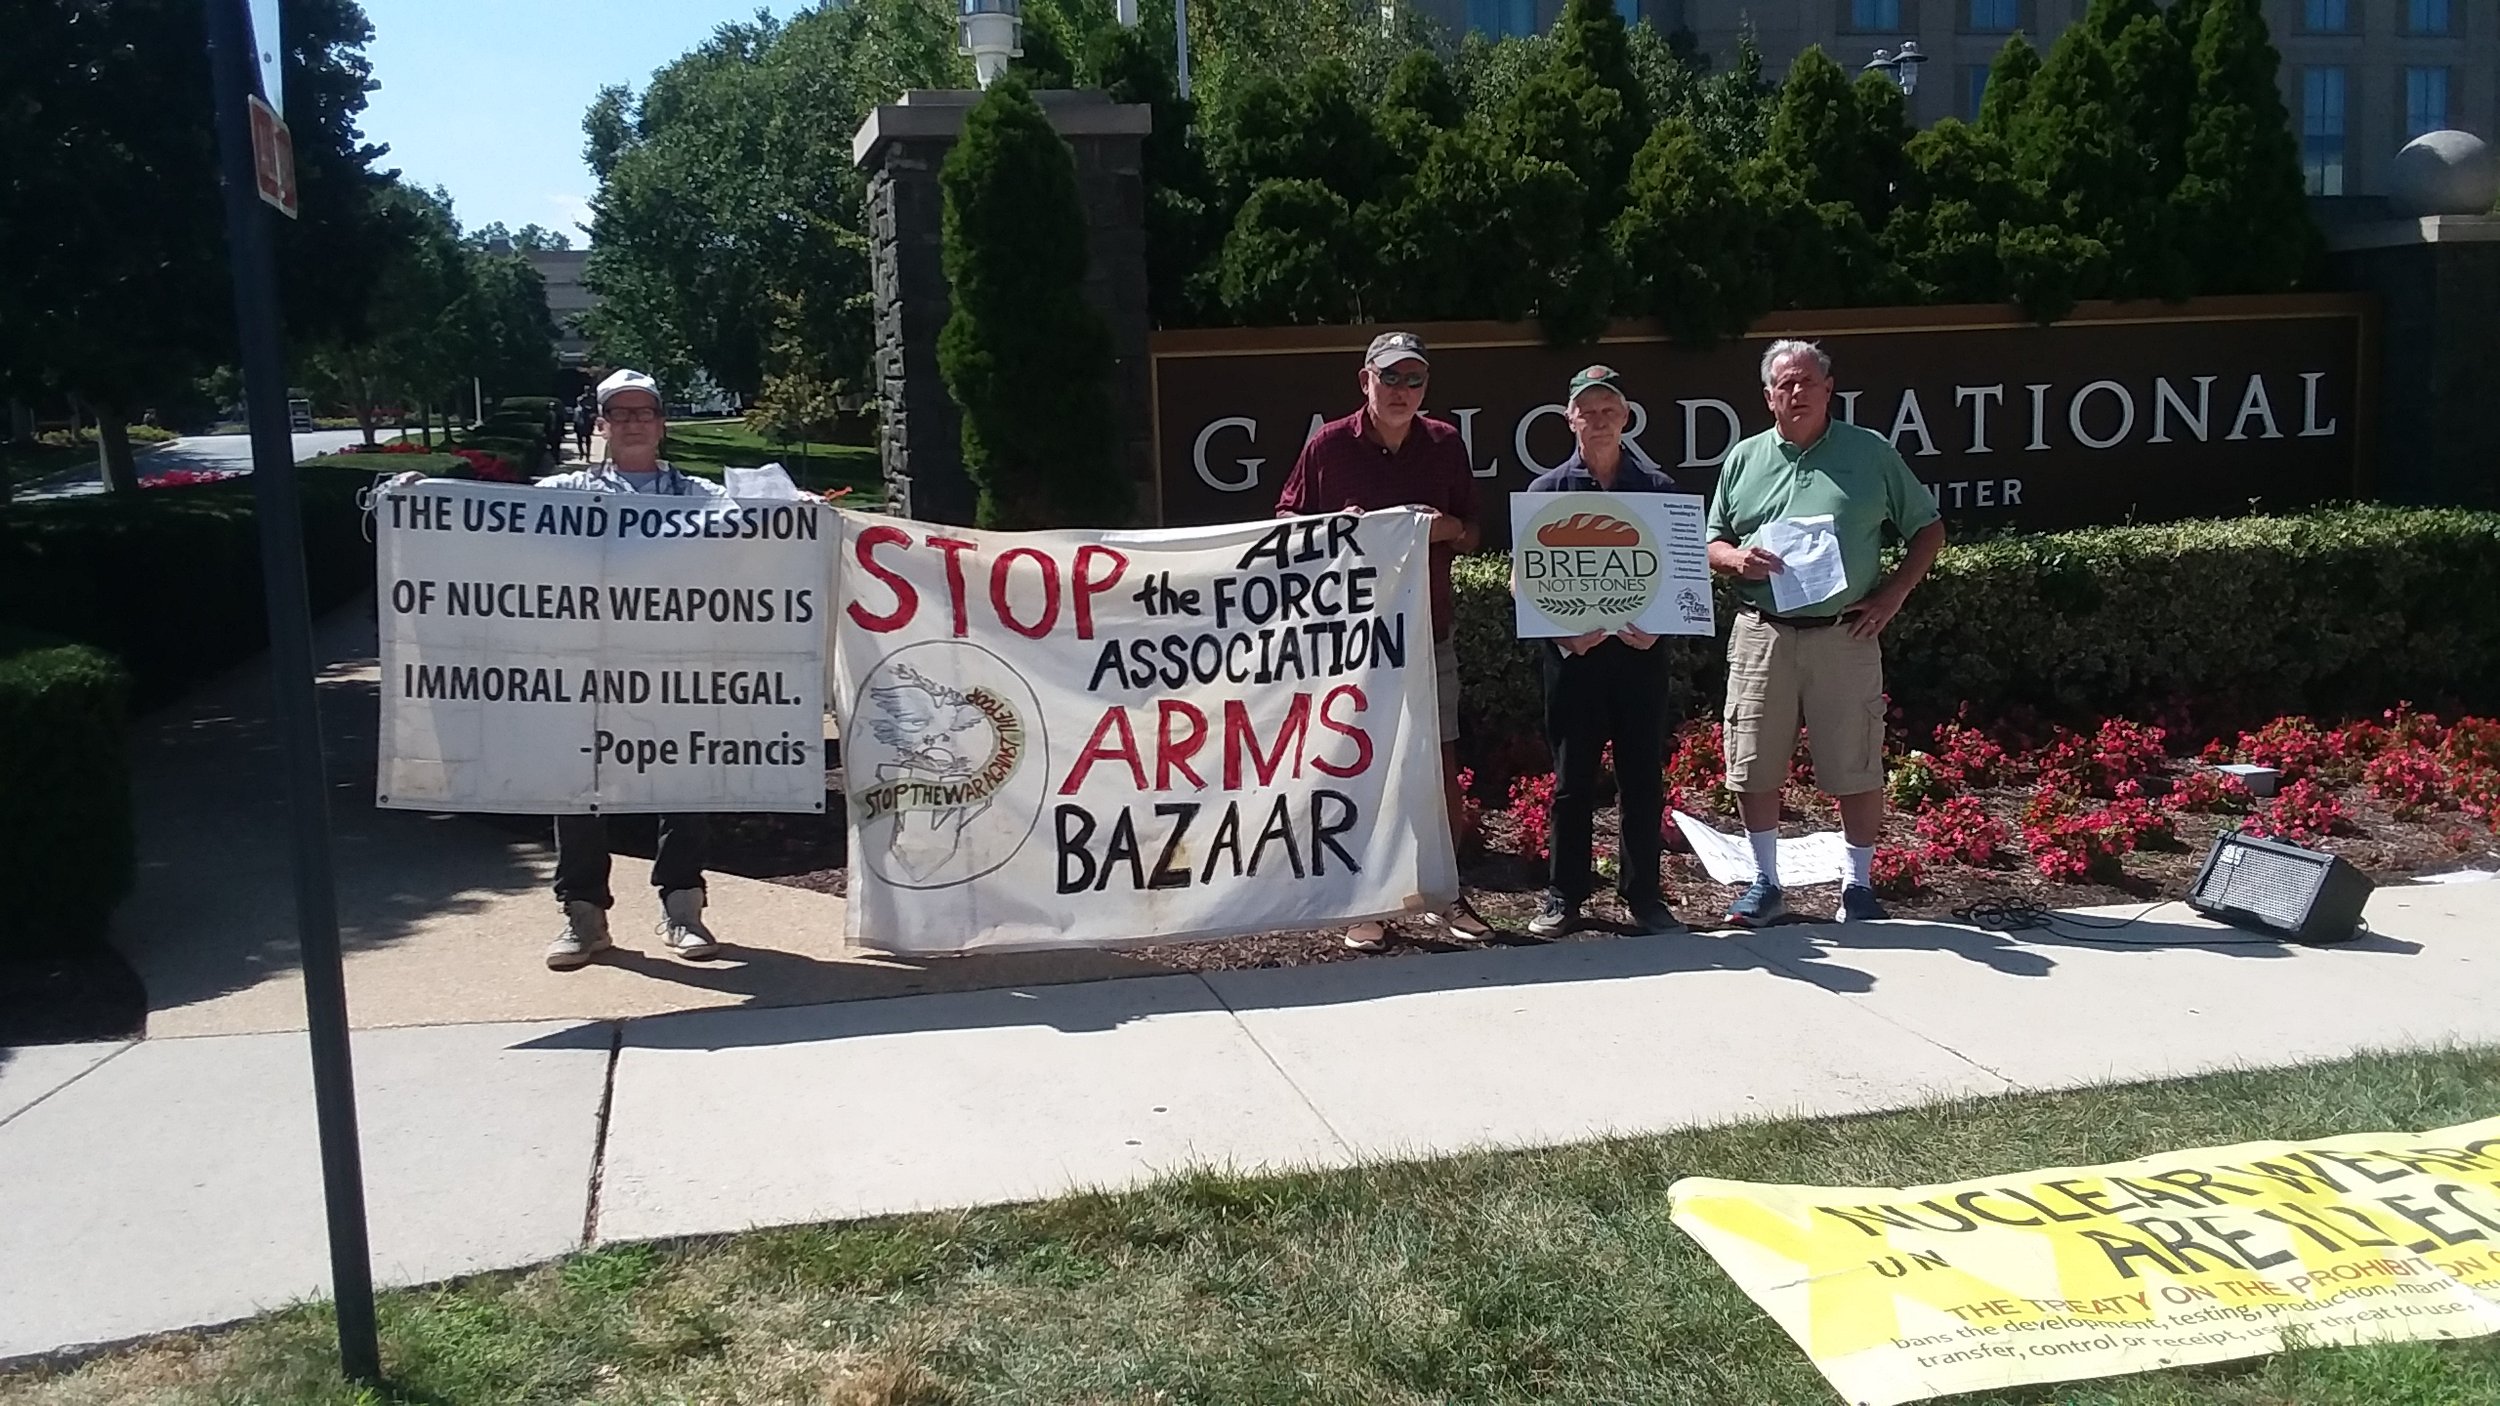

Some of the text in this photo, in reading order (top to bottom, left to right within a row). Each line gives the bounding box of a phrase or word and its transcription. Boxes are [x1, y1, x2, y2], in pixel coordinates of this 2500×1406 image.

[1192, 398, 1741, 491] GLORD
[389, 495, 817, 540] THE USE AND POSSESSION
[1236, 515, 1365, 571] AIR
[846, 525, 1203, 640] STOP the
[1524, 549, 1658, 579] BREAD
[1538, 578, 1646, 593] NOT STONES
[392, 579, 814, 623] OF NUCLEAR WEAPONS IS
[1215, 567, 1378, 628] FORCE
[1088, 613, 1406, 691] ASSOCIATION
[405, 664, 801, 706] IMMORAL AND ILLEGAL.
[580, 730, 806, 774] -Pope Francis
[1057, 684, 1375, 795] ARMS
[865, 784, 909, 820] STOP
[910, 783, 943, 806] THE
[942, 779, 988, 804] WAR
[1055, 789, 1362, 895] BAZAAR
[1815, 1169, 2264, 1237] NUCLEAR
[1868, 1250, 1951, 1278] UN
[2076, 1216, 2298, 1279] ARE
[1890, 1334, 1953, 1349] bans
[1956, 1325, 2000, 1338] the
[2003, 1315, 2169, 1332] development,
[2168, 1304, 2262, 1326] testing,
[2262, 1282, 2397, 1318] production,
[1944, 1300, 2021, 1321] THE
[2020, 1291, 2151, 1315] TREATY
[2161, 1285, 2218, 1304] ON
[2214, 1281, 2290, 1296] THE
[2287, 1256, 2488, 1296] PROHIBITON
[1917, 1343, 2026, 1368] transfer,
[2029, 1334, 2118, 1356] control
[2123, 1337, 2146, 1346] or
[2152, 1330, 2246, 1347] receipt,
[2321, 1303, 2396, 1327] threat
[2394, 1305, 2422, 1316] to
[2424, 1303, 2474, 1314] use,
